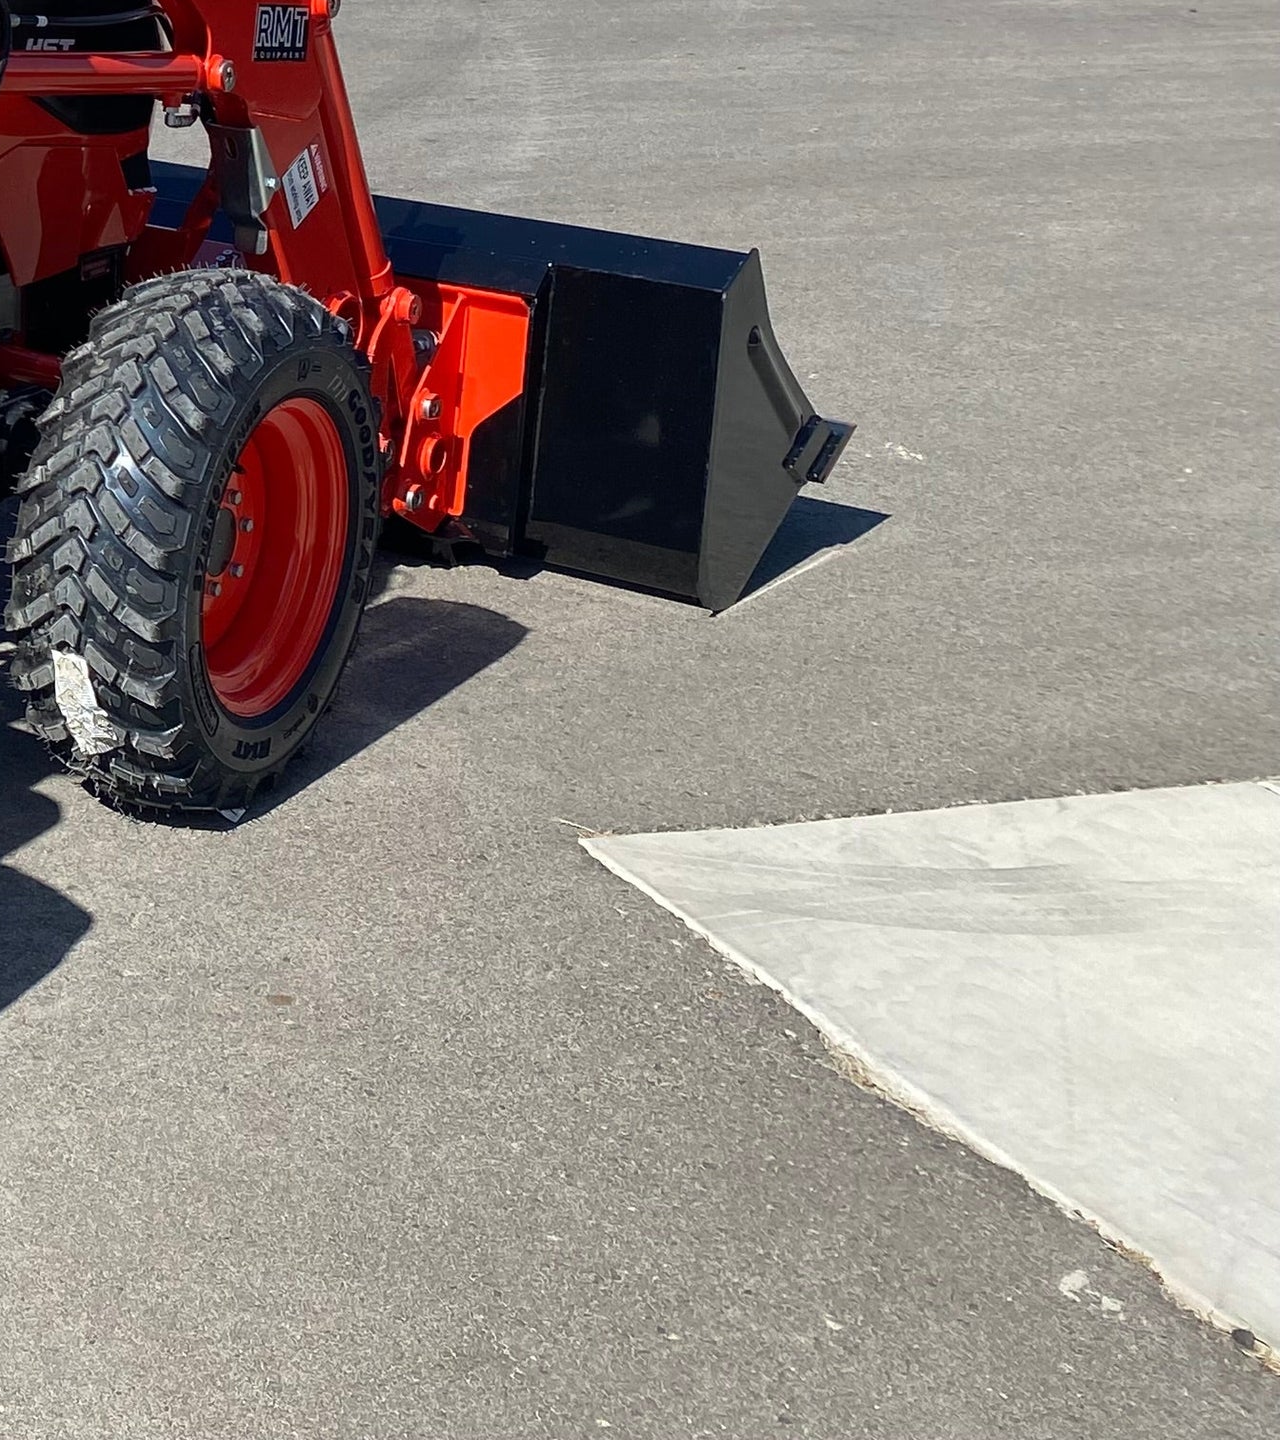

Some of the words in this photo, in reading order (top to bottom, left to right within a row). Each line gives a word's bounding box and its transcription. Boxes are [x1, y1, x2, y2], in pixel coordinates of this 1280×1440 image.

[255, 6, 309, 48] RMT
[253, 50, 306, 60] EQUIPMENT
[346, 388, 376, 604] GOODYEAR
